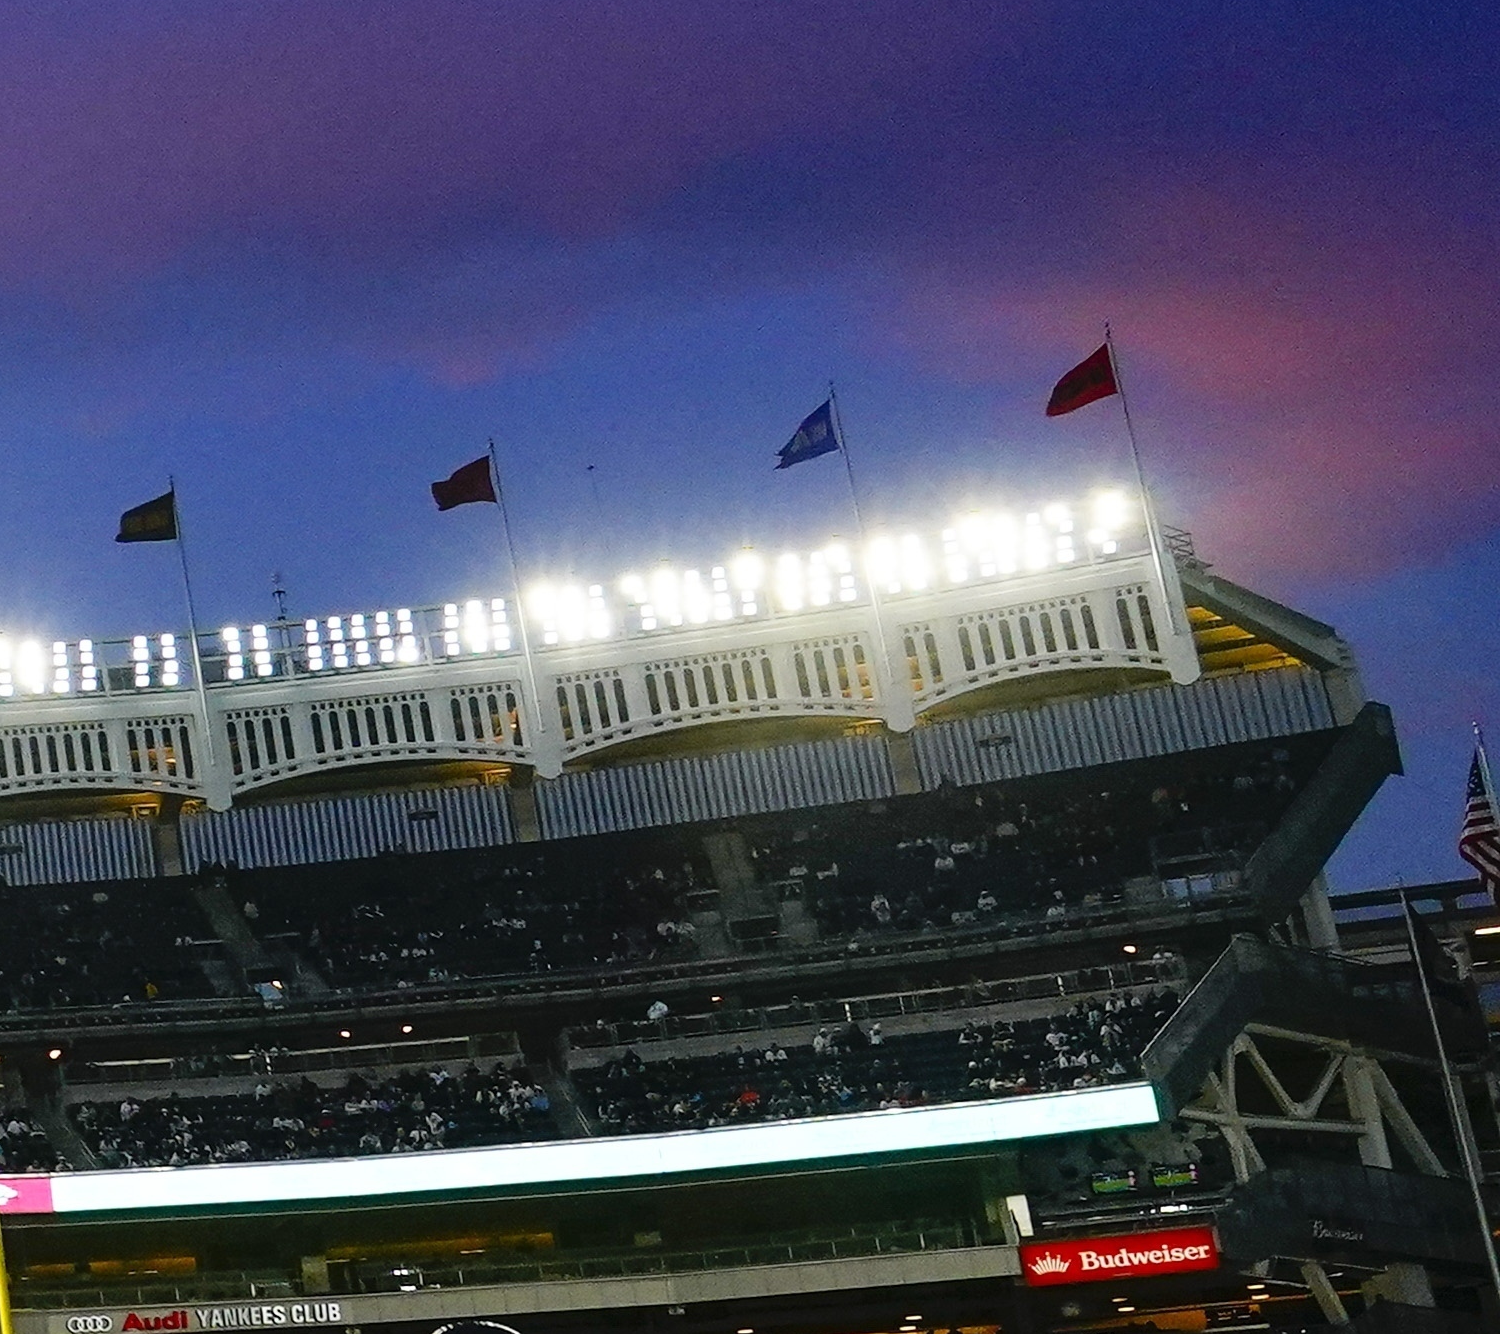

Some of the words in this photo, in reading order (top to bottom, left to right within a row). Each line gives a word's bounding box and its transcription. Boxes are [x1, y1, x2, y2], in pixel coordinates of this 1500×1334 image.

[1078, 1244, 1210, 1271] Budweiser
[121, 1310, 188, 1331] Audi
[196, 1304, 286, 1328] YANKEES
[291, 1303, 341, 1323] CLUB
